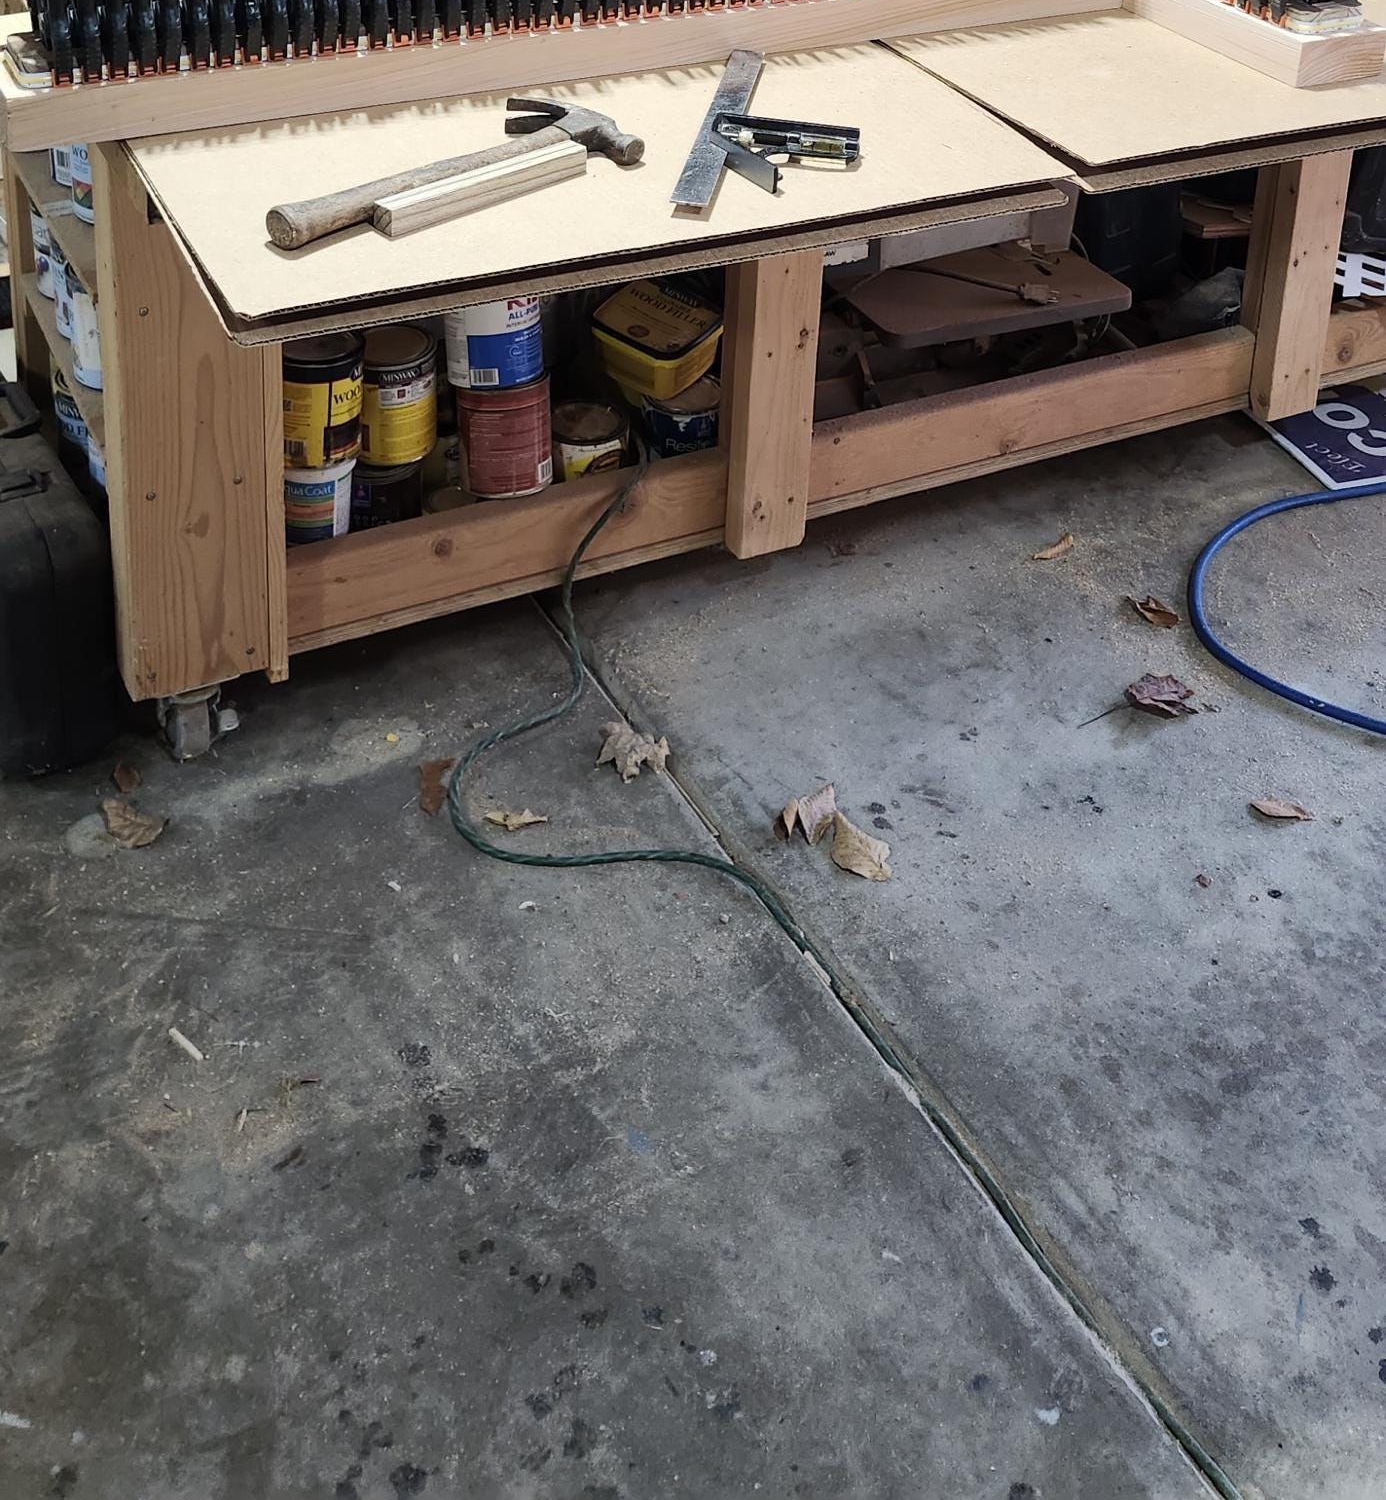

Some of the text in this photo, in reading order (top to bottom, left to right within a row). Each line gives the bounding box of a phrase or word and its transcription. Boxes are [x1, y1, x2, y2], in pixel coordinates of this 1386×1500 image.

[629, 288, 667, 310] WOOD
[665, 306, 707, 328] FILLER
[381, 367, 420, 382] MINWAX
